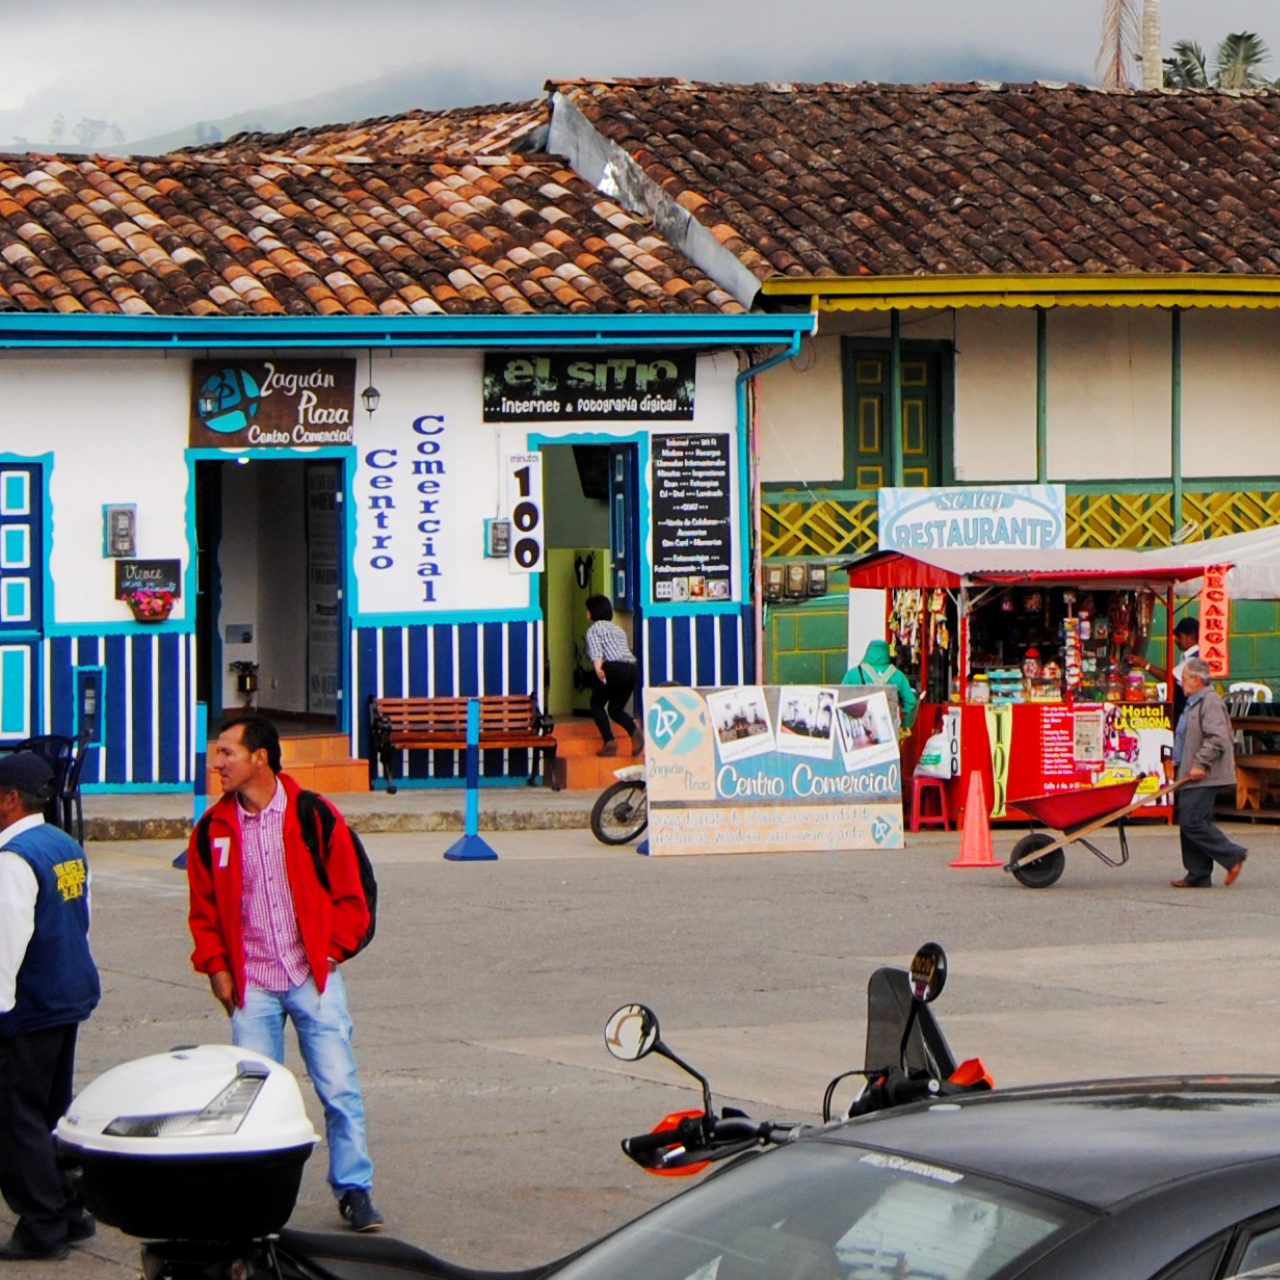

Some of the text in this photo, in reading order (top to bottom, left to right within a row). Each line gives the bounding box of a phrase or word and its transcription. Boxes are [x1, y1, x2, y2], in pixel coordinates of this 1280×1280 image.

[260, 362, 335, 397] Zaguán
[298, 390, 349, 424] Plaza
[577, 396, 638, 413] fotografía
[248, 425, 353, 443] Centro Comercial
[365, 449, 398, 569] Centro
[411, 415, 446, 602] Comercial
[513, 465, 540, 568] 100
[895, 517, 1054, 549] RESTAURANTE
[1121, 704, 1165, 718] Hostal
[950, 717, 959, 775] 100
[717, 763, 898, 798] Centro Comercial
[214, 836, 231, 867] 7
